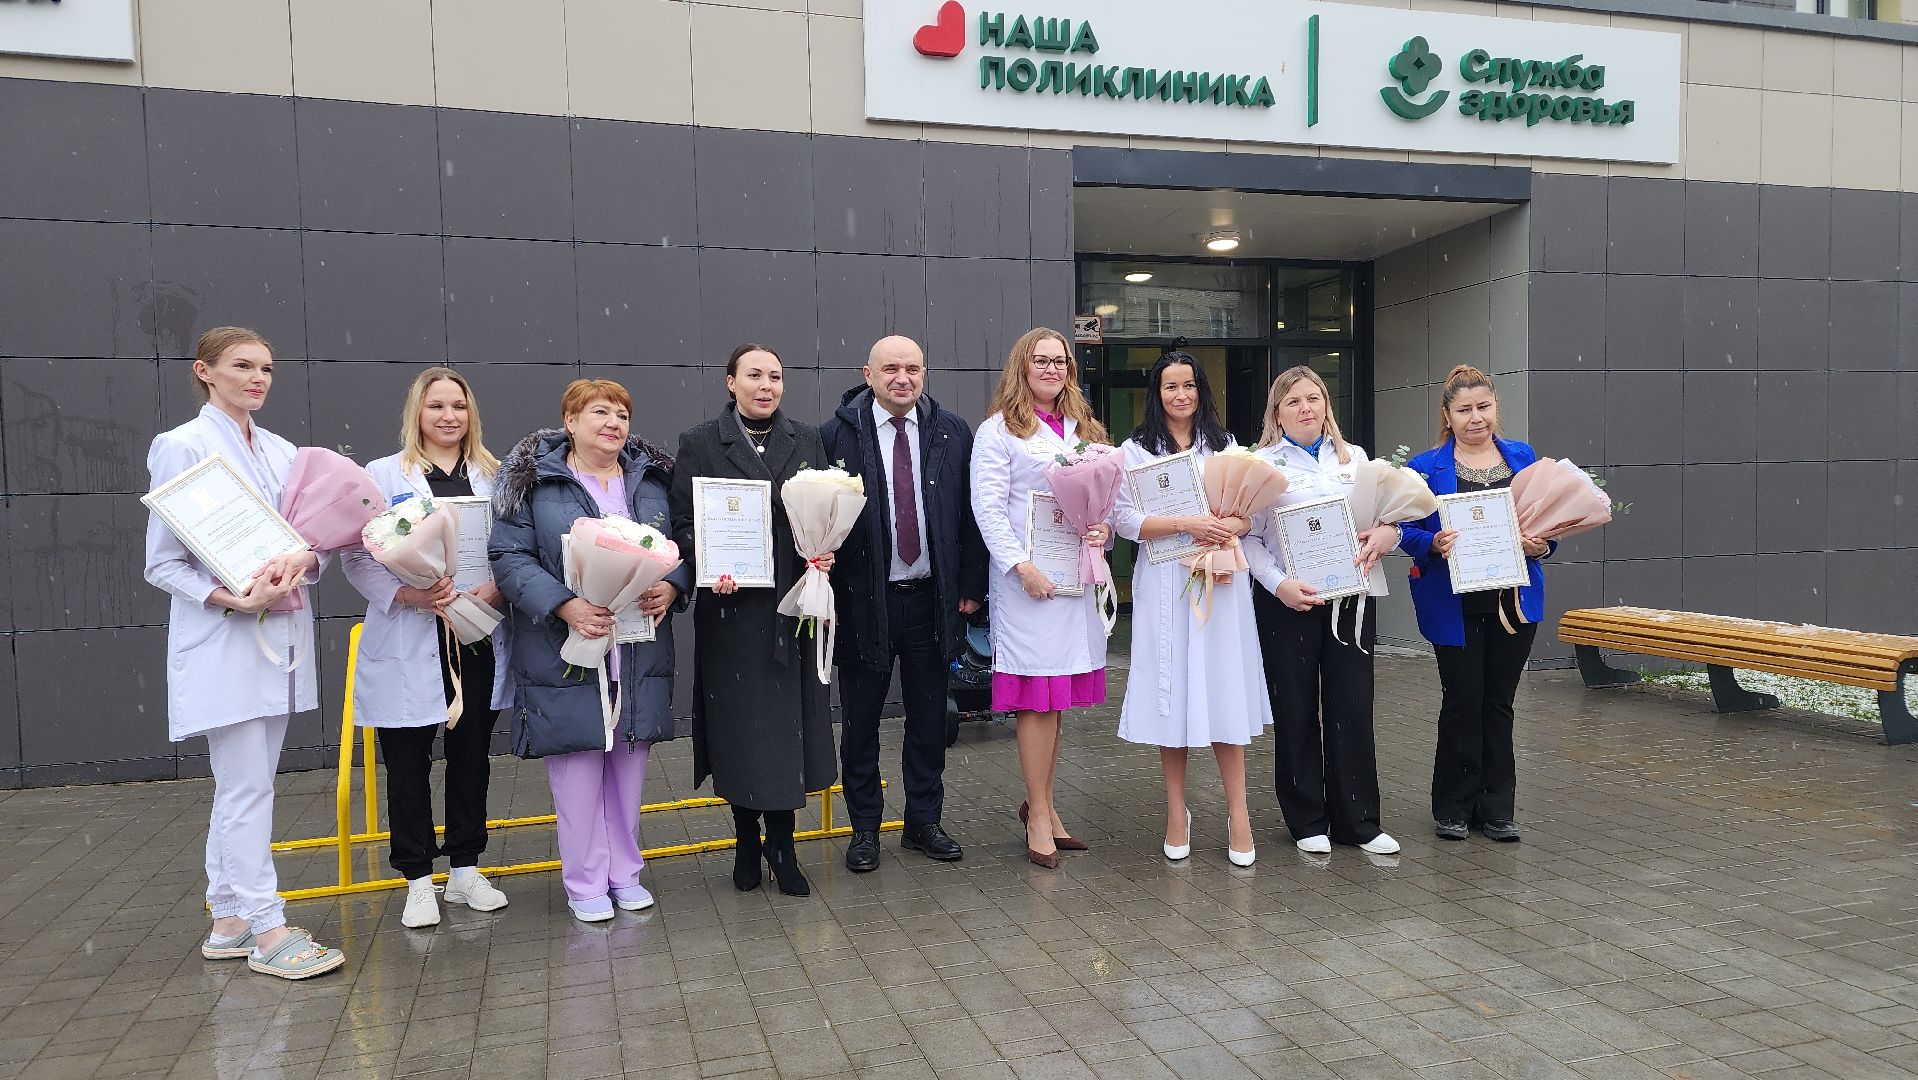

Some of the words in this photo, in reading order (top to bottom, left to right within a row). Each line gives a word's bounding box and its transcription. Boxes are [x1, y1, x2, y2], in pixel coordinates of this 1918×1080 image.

[979, 11, 1100, 54] НАША
[979, 55, 1276, 108] ПОЛИКЛИНИКА
[1459, 48, 1606, 93] Служба
[1458, 89, 1635, 127] здоровья
